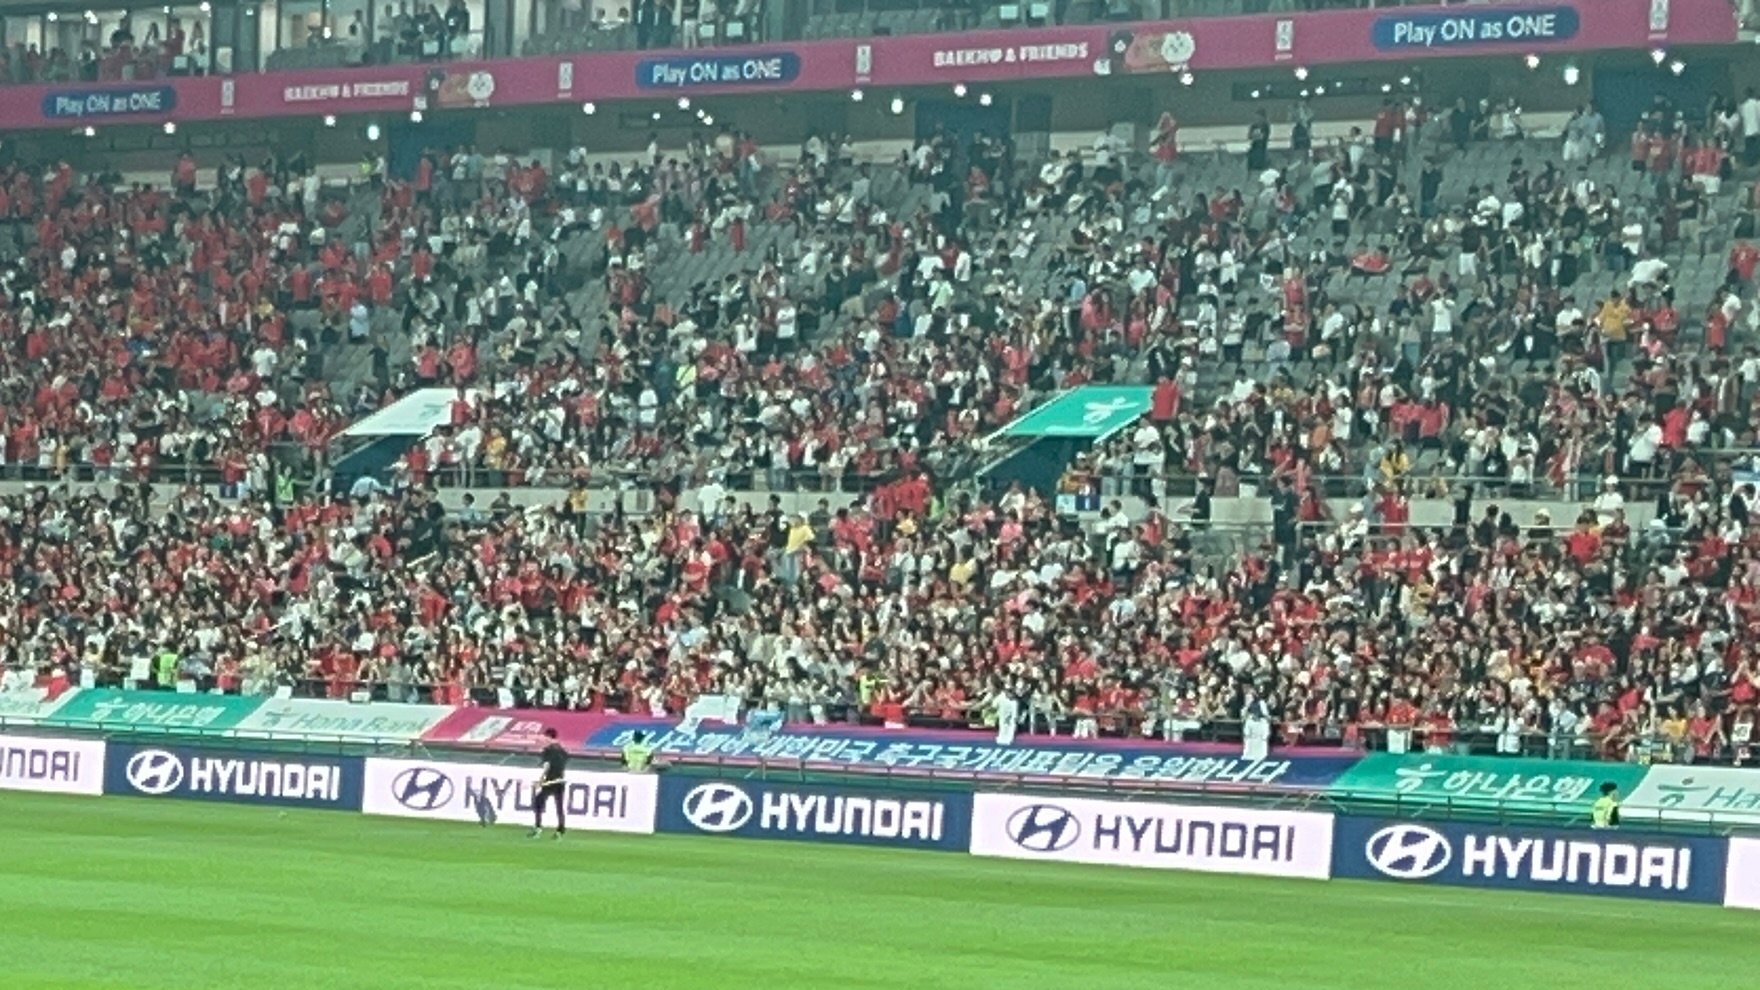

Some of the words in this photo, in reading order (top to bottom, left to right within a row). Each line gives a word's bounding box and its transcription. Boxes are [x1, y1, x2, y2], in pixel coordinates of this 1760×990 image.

[1394, 22, 1436, 47] Play
[1440, 18, 1475, 41] ON
[1480, 21, 1502, 38] as
[1507, 14, 1555, 37] ONE
[1019, 42, 1089, 61] FRIENDS
[652, 63, 686, 87] Play
[691, 62, 718, 81] ON
[722, 65, 740, 80] as
[743, 58, 782, 79] ONE
[86, 94, 110, 112] ON
[130, 91, 161, 110] ONE
[190, 757, 340, 800] HYUNDAI
[1444, 770, 1593, 800] 하나은행
[761, 793, 944, 841] HYUNDAI
[1093, 814, 1296, 862] HYUNDAI
[1463, 834, 1691, 890] HYUNDAI
